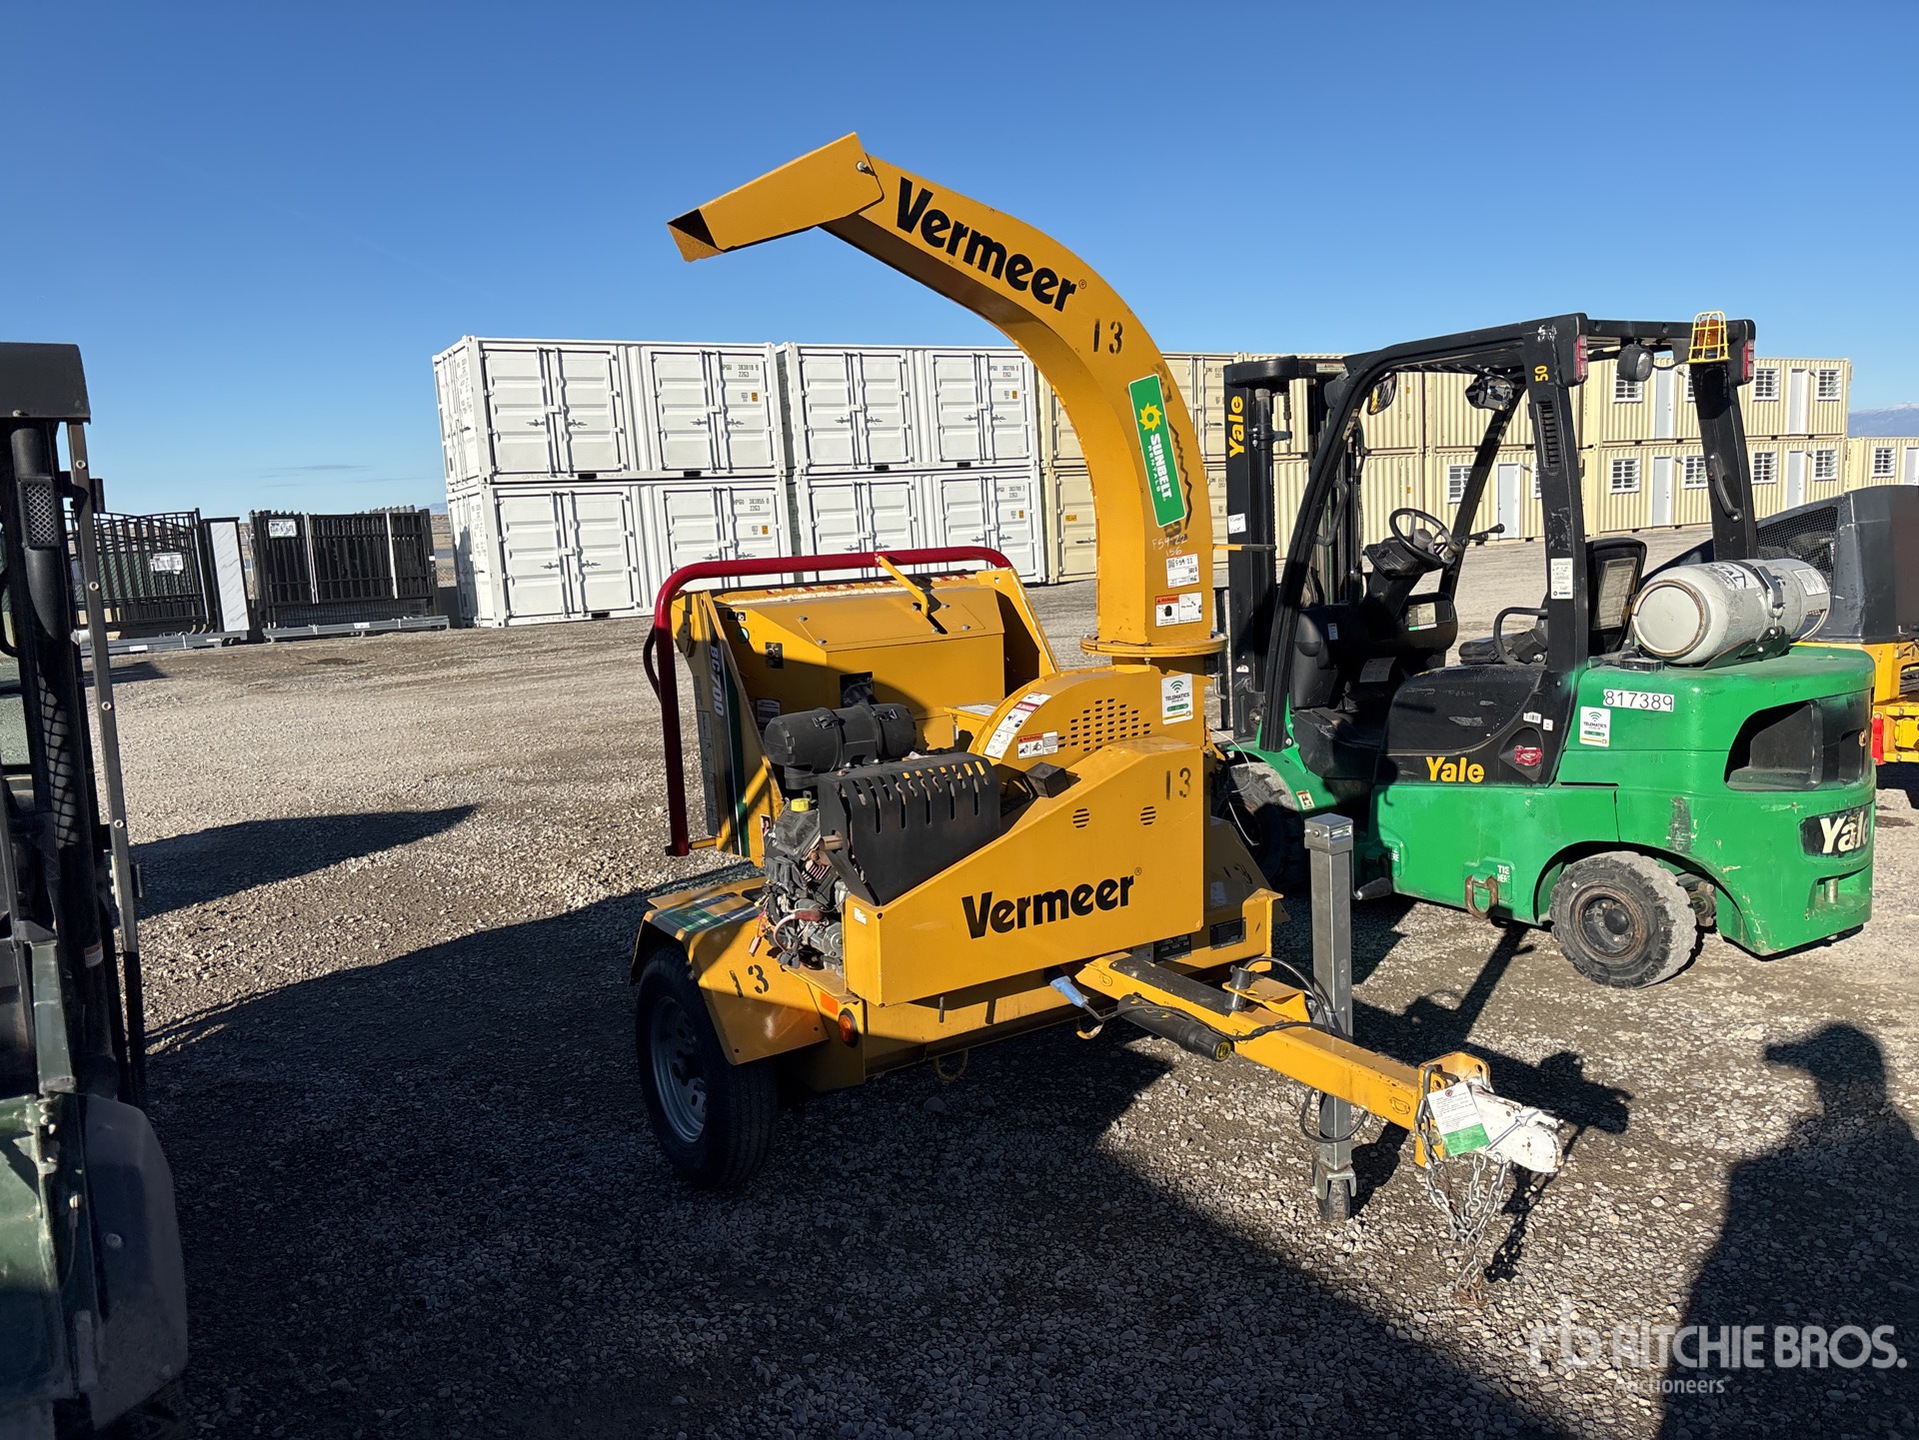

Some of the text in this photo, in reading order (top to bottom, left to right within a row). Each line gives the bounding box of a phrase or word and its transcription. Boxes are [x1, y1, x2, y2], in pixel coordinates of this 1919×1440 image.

[897, 177, 1077, 312] Vermeer
[1534, 365, 1549, 382] 50
[1228, 395, 1244, 458] Yale
[1147, 445, 1161, 493] RENTALS
[1150, 433, 1173, 498] SUNBELT
[709, 645, 724, 717] BC700
[1165, 692, 1190, 701] TELEMATICS
[1605, 690, 1673, 711] 817389
[1165, 767, 1191, 800] 13
[1425, 756, 1484, 783] Yale
[1497, 864, 1510, 875] TIE
[961, 875, 1134, 939] Vermeer
[729, 964, 770, 998] 13
